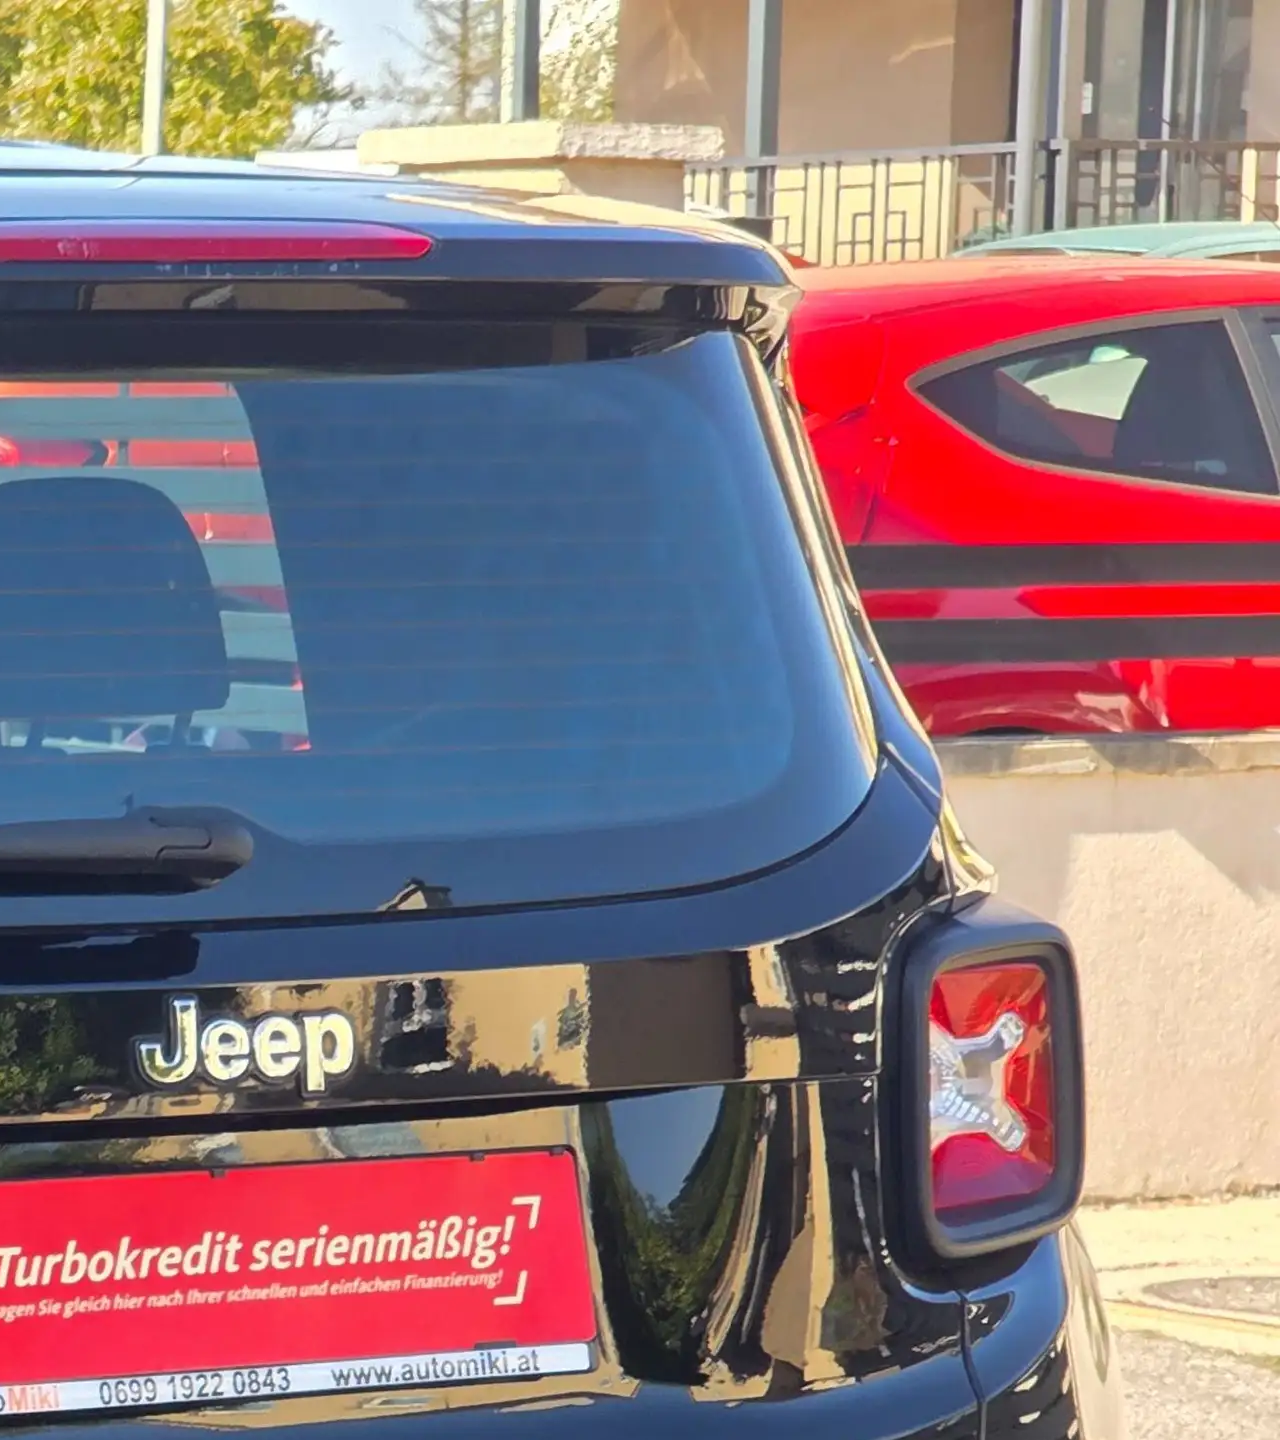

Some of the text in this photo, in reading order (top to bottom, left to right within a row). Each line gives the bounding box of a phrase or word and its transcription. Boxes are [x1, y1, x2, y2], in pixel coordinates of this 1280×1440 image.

[139, 996, 355, 1092] Jeep
[249, 1215, 516, 1272] serienmäßig!
[38, 1297, 61, 1317] Sie
[63, 1293, 111, 1320] gleich
[113, 1291, 143, 1311] hier
[145, 1286, 183, 1309] nach
[186, 1286, 223, 1306] Ihrer
[226, 1281, 298, 1303] schnellen
[299, 1280, 328, 1299] und
[329, 1276, 401, 1297] einfachen
[403, 1267, 505, 1291] Finanzierung!
[98, 1376, 158, 1407] 0699
[167, 1370, 225, 1401] 1922
[232, 1364, 292, 1395] 0843
[330, 1348, 540, 1388] www.automiki.at
